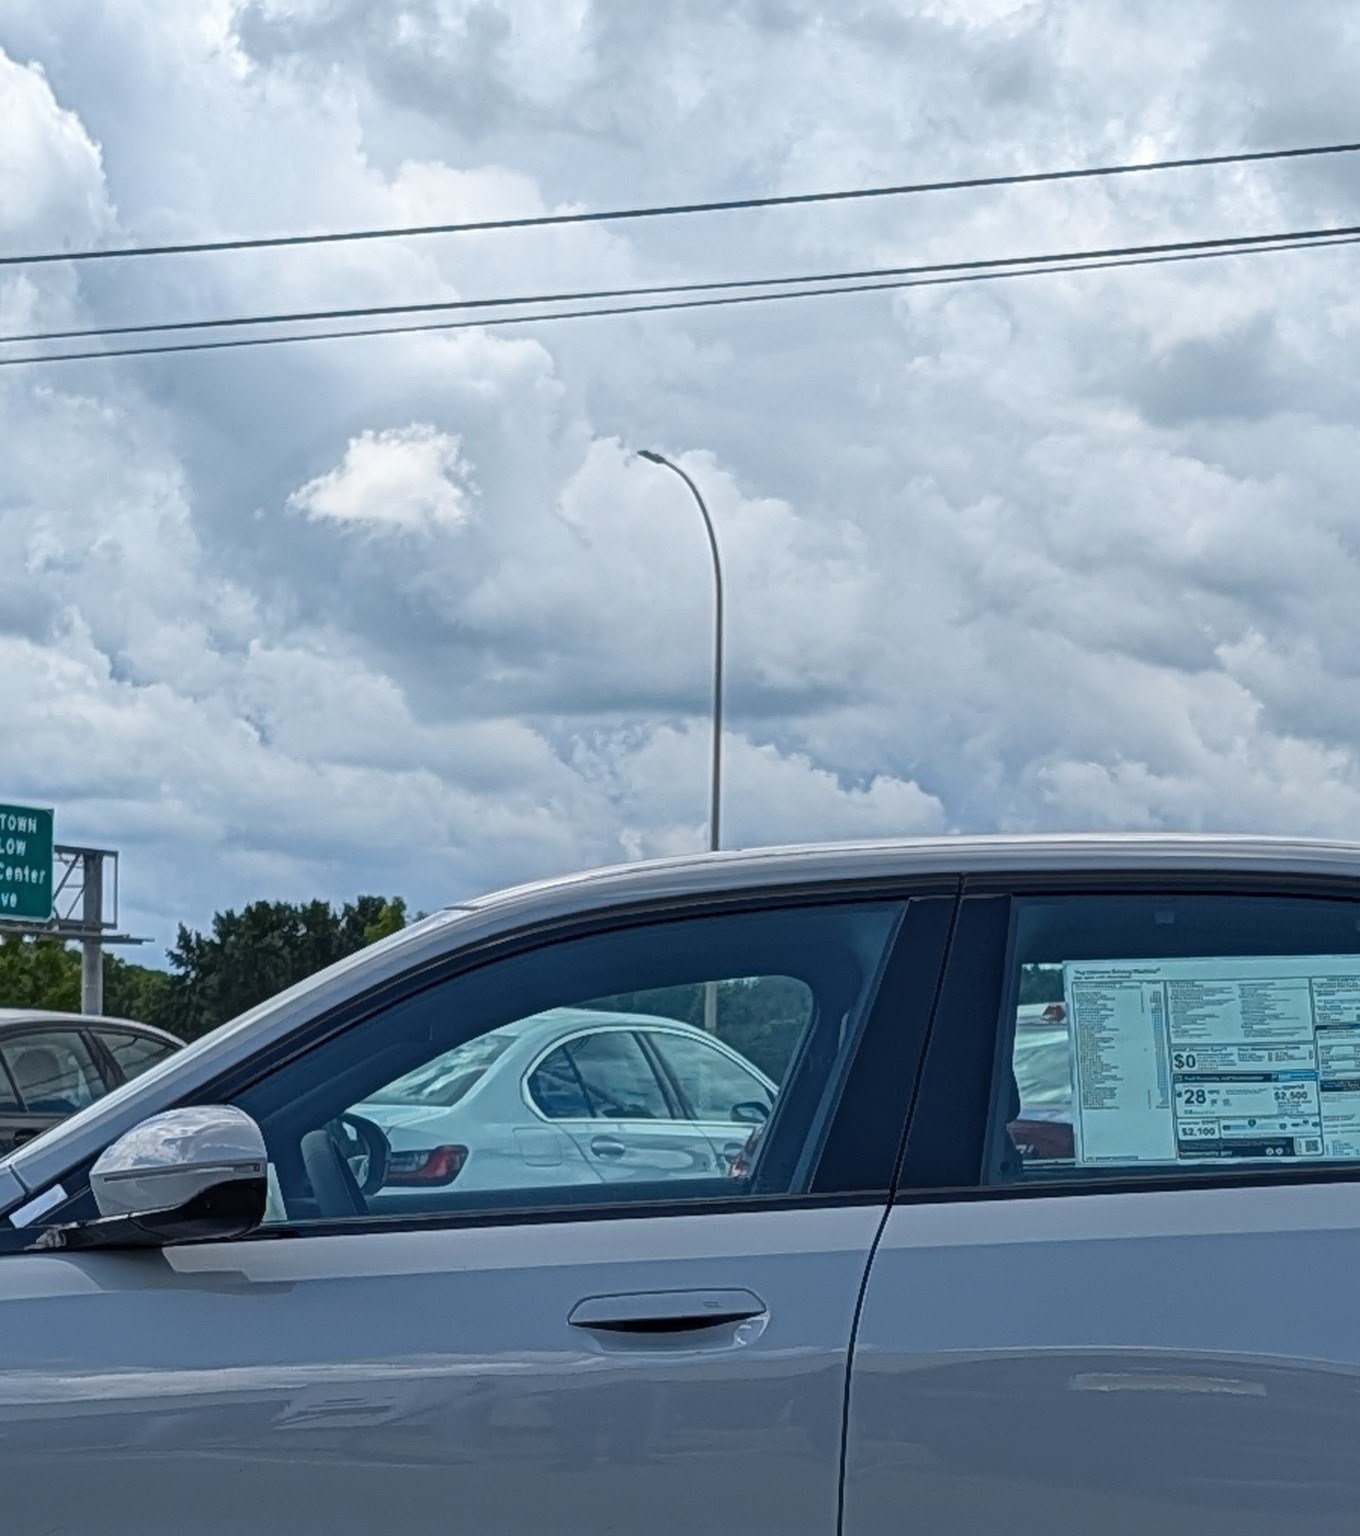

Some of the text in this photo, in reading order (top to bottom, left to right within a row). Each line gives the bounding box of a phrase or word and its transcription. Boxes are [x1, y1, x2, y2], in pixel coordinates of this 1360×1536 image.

[1173, 1053, 1196, 1069] $0
[1184, 1089, 1207, 1104] 28
[1181, 1127, 1216, 1137] $2,100
